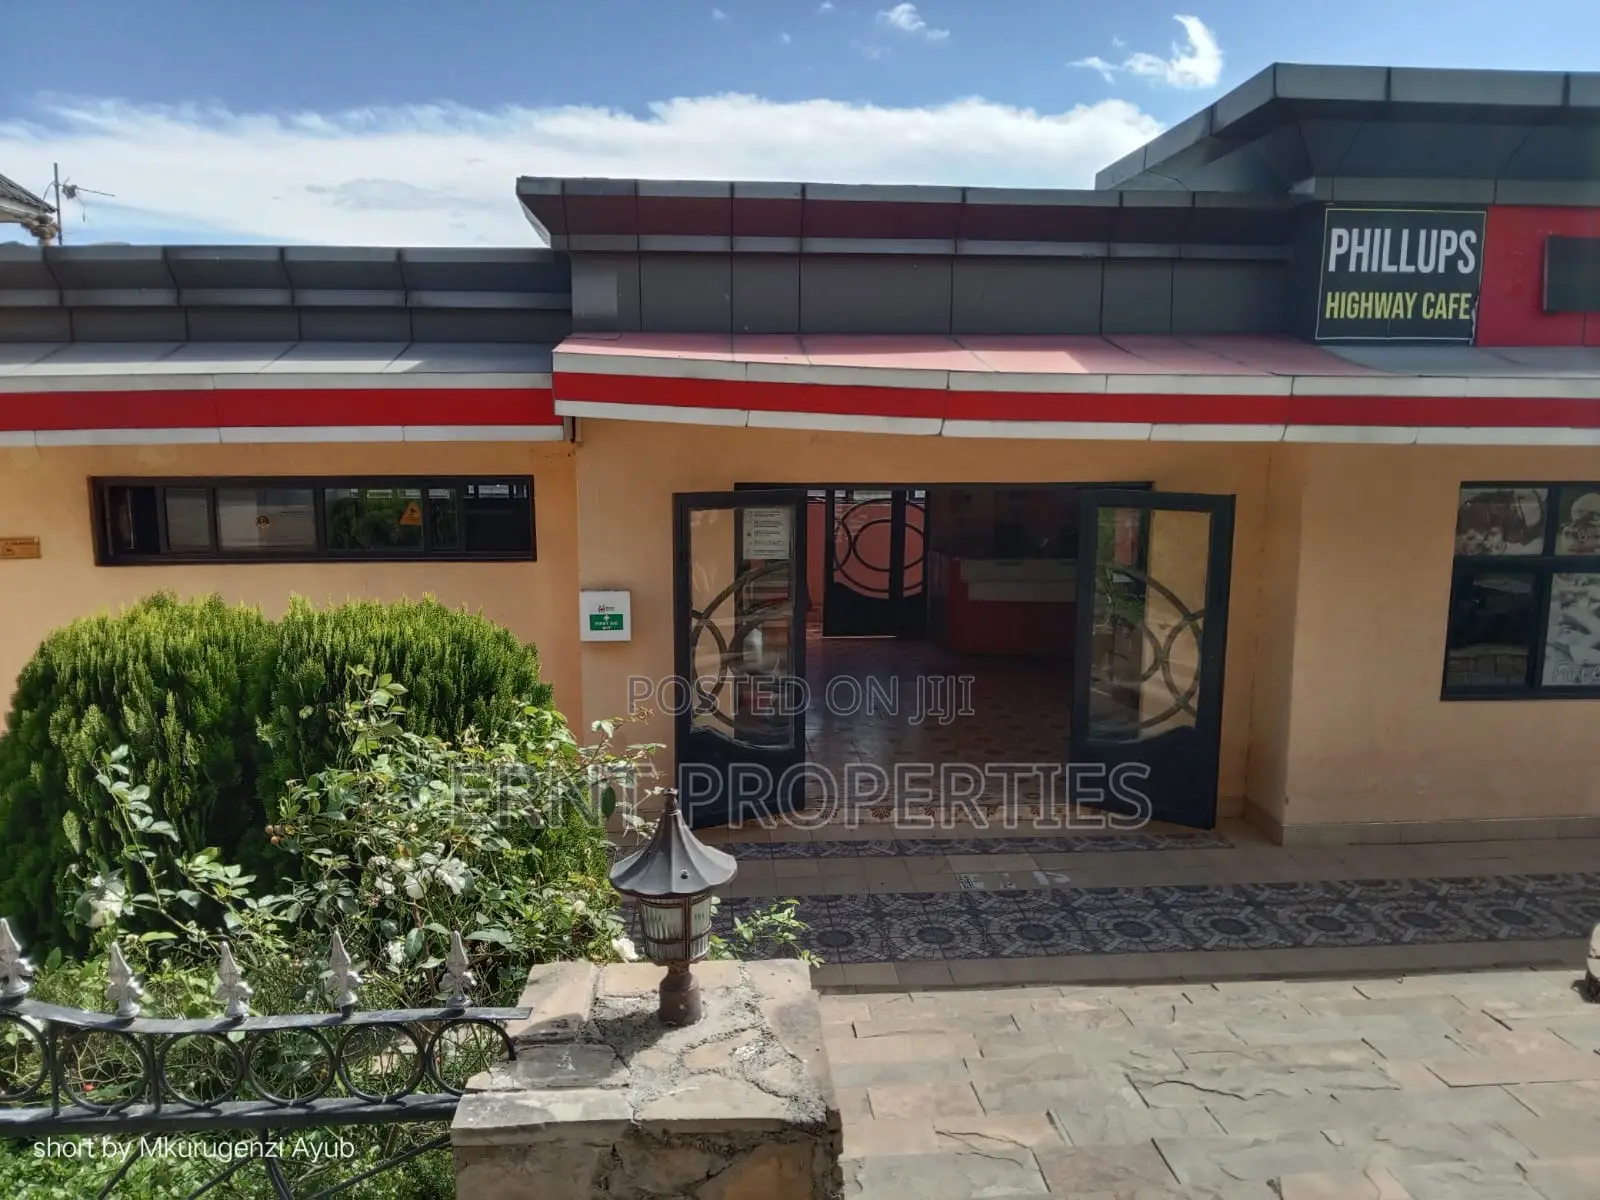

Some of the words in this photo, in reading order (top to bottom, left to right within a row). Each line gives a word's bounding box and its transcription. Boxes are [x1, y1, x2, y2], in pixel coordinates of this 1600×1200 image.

[1328, 228, 1477, 274] PHILLUPS
[1325, 291, 1418, 320] HIGHWAY
[1422, 292, 1472, 320] CAFE
